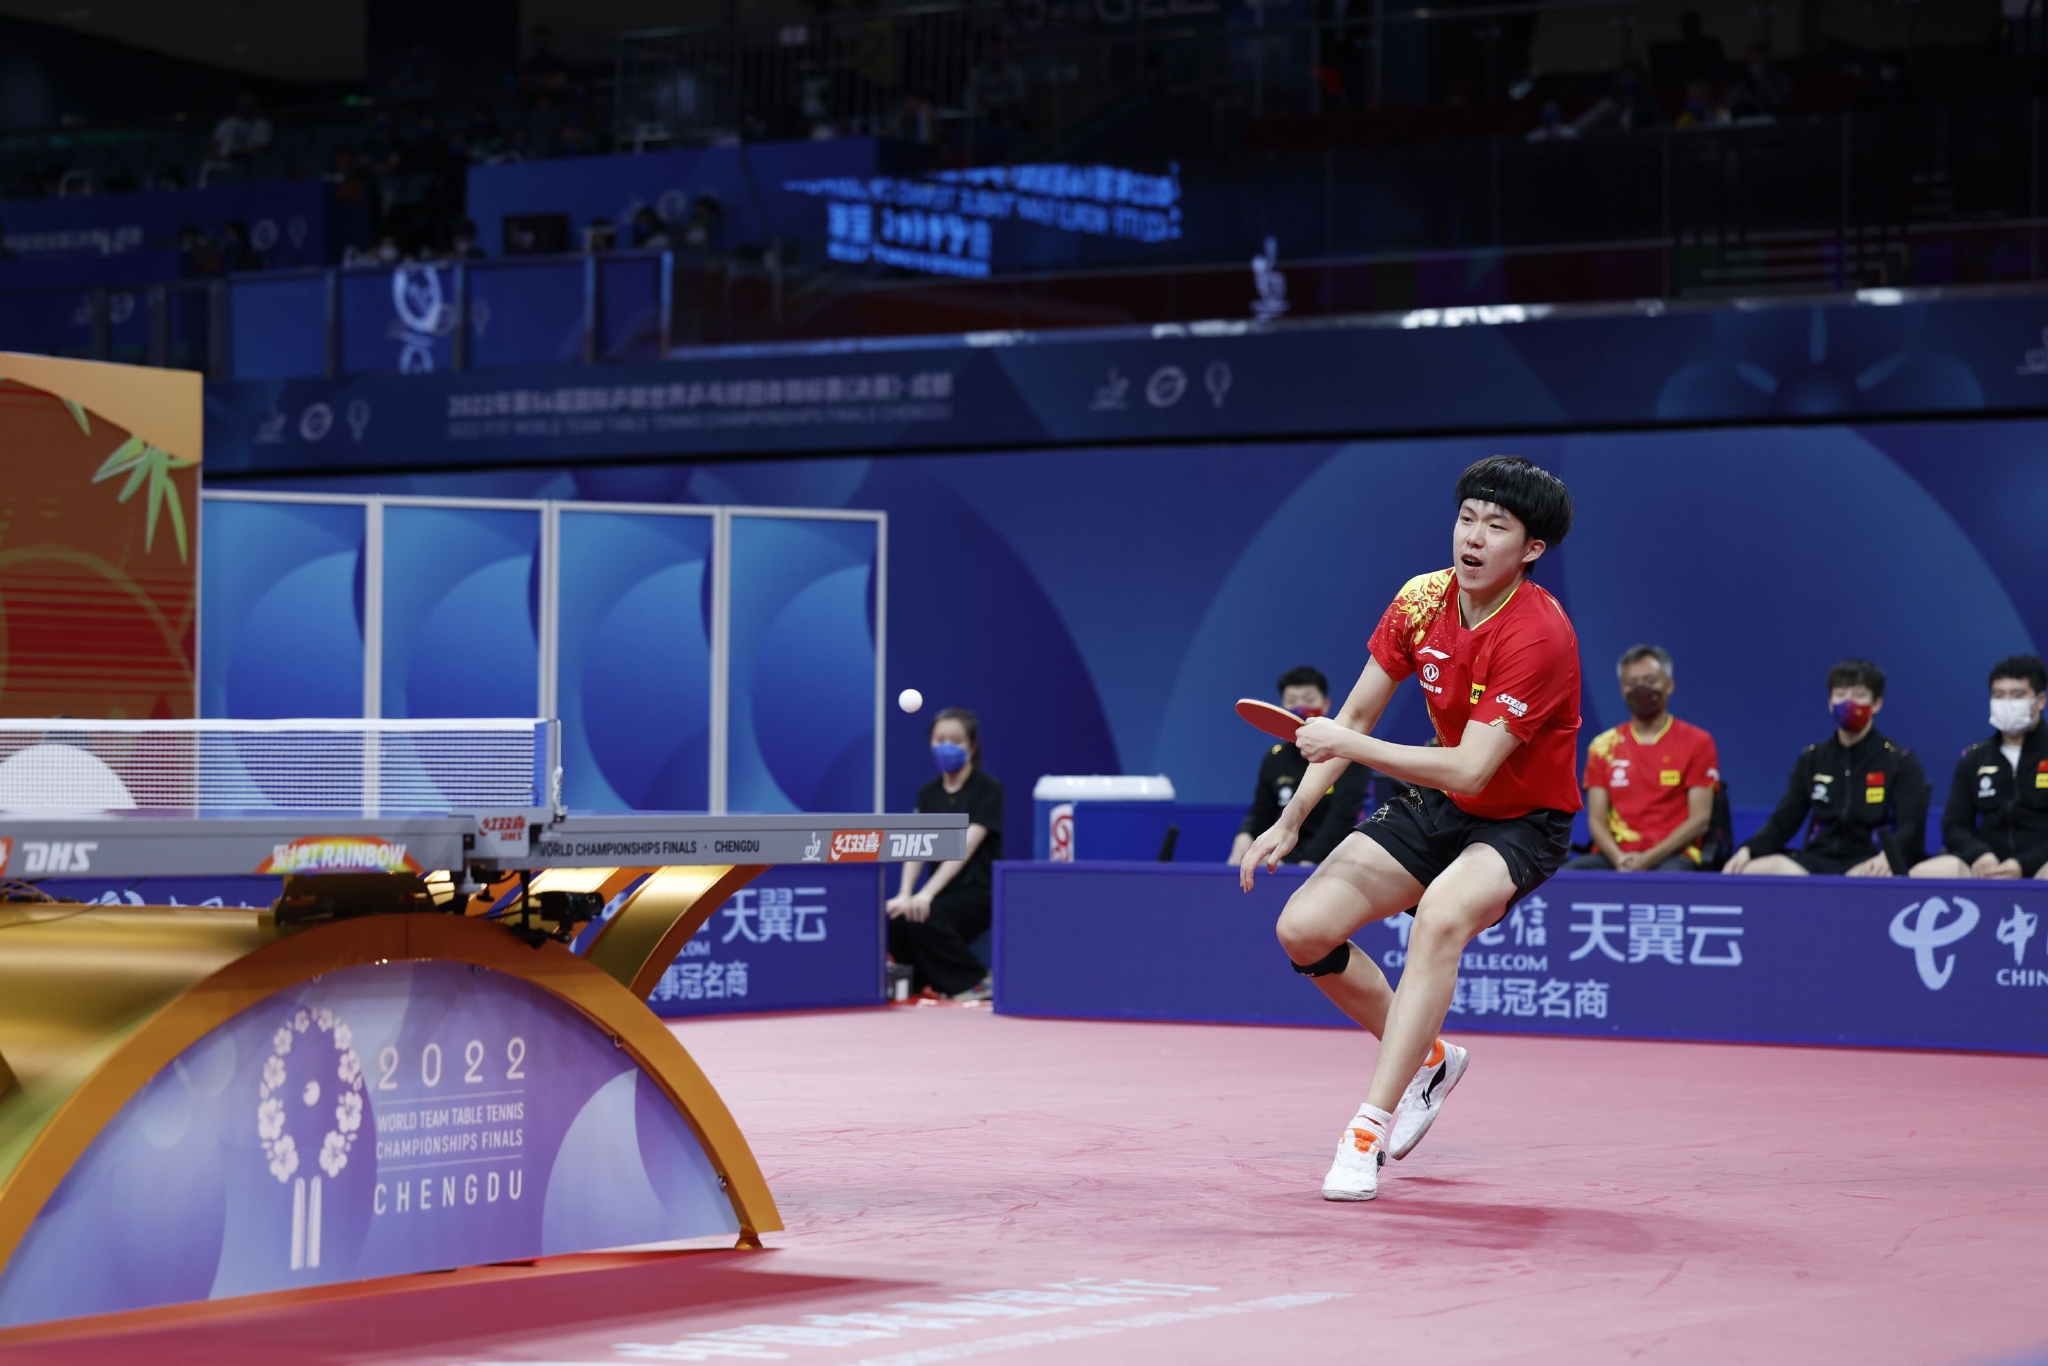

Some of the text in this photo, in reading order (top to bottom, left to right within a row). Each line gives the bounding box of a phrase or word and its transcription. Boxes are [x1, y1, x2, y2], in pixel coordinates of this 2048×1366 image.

[22, 841, 98, 873] DHS
[321, 843, 407, 868] RAINBOW
[575, 841, 661, 857] CHAMPIONSHIPS
[663, 840, 697, 855] FINALS
[714, 840, 760, 854] CHENGDU
[831, 832, 880, 861] 红双喜
[889, 833, 939, 858] DHS
[722, 886, 828, 944] 天翼云
[1568, 902, 1744, 966] 天翼云
[646, 960, 749, 1001] 事冠名商
[377, 1037, 527, 1091] 2022
[377, 1102, 525, 1133] WORLD TEAM TABLE TENNIS
[375, 1128, 523, 1161] CHAMPIONSHIPS FINALS
[373, 1168, 523, 1216] CHENGDU
